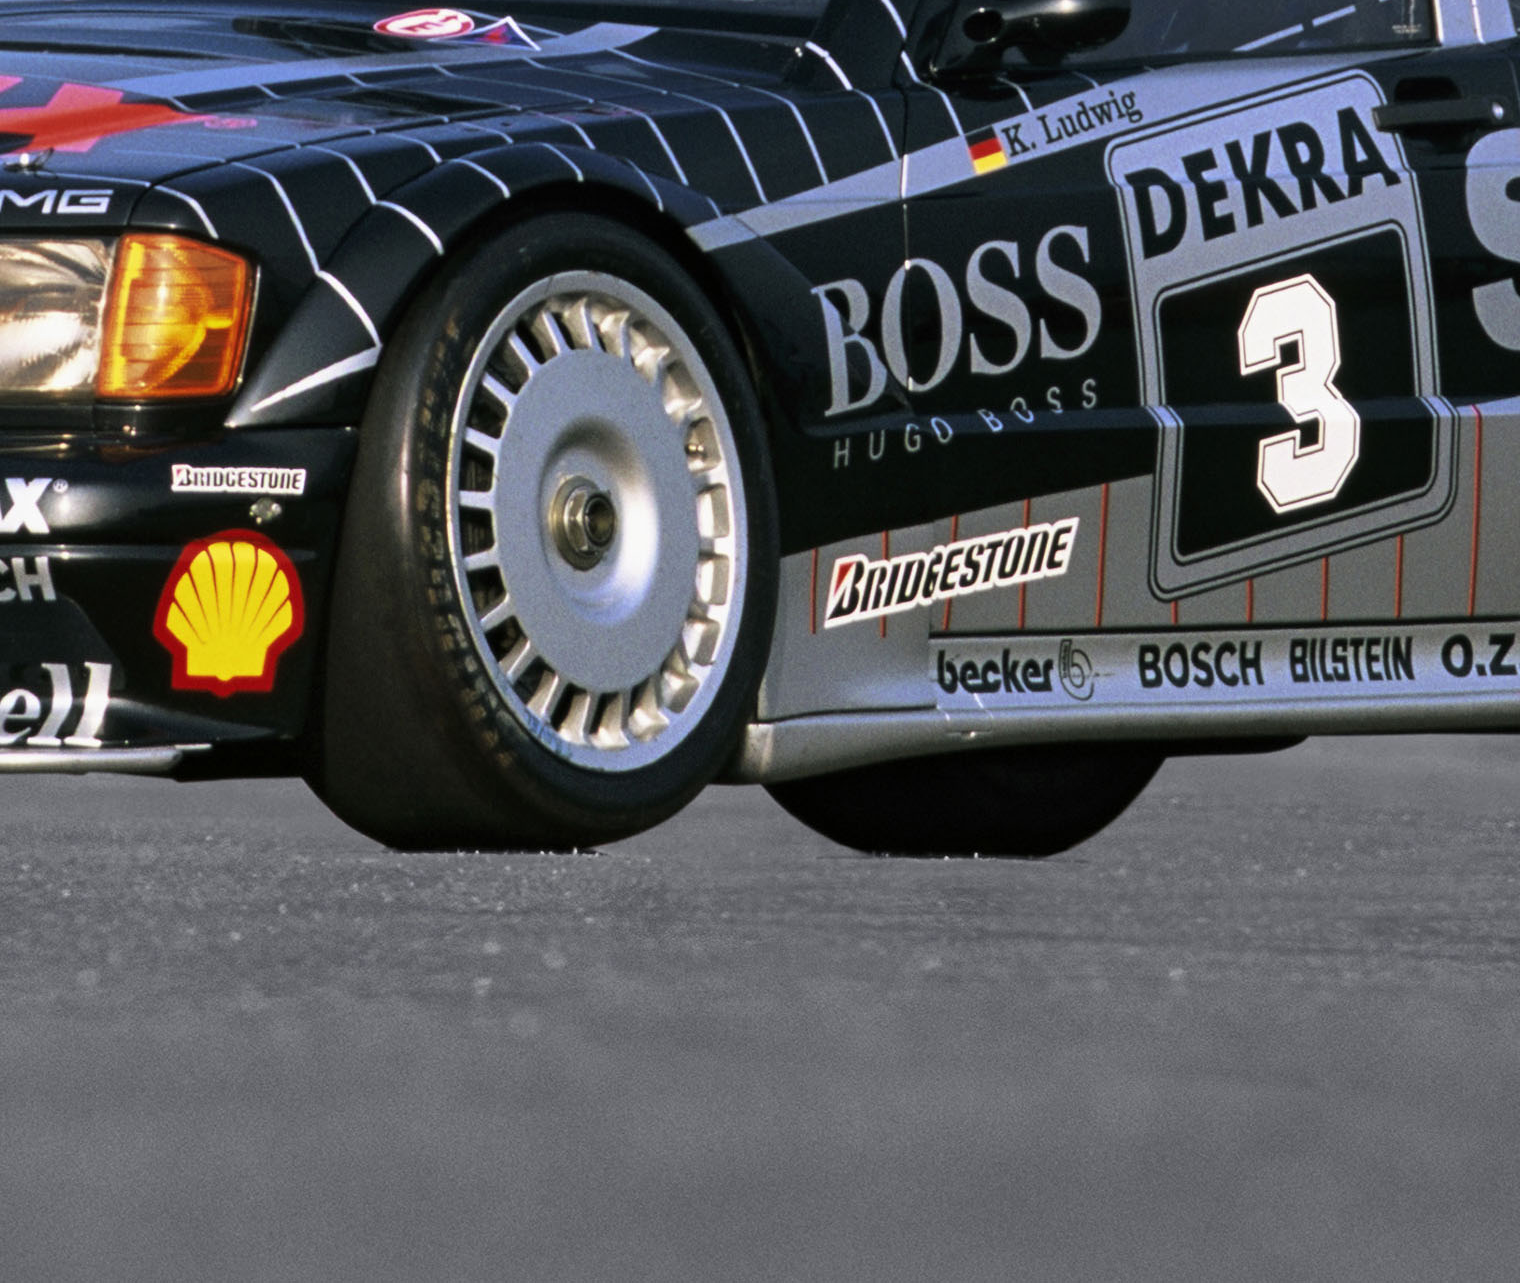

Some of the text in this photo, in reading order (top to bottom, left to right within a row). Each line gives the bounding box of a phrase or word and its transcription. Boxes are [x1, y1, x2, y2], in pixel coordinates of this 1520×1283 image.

[1043, 89, 1144, 141] Ludwig
[1124, 106, 1401, 260] DEKRA
[810, 224, 1102, 417] BOSS
[834, 378, 1097, 468] HUGO BOSS
[1238, 273, 1361, 514] 3
[174, 466, 304, 492] BRIDGESTONE
[825, 523, 1075, 622] BRIDGESTONE
[937, 648, 1054, 693] becker
[1138, 641, 1265, 688] BOSCH
[1289, 636, 1414, 683] BILSTEIN
